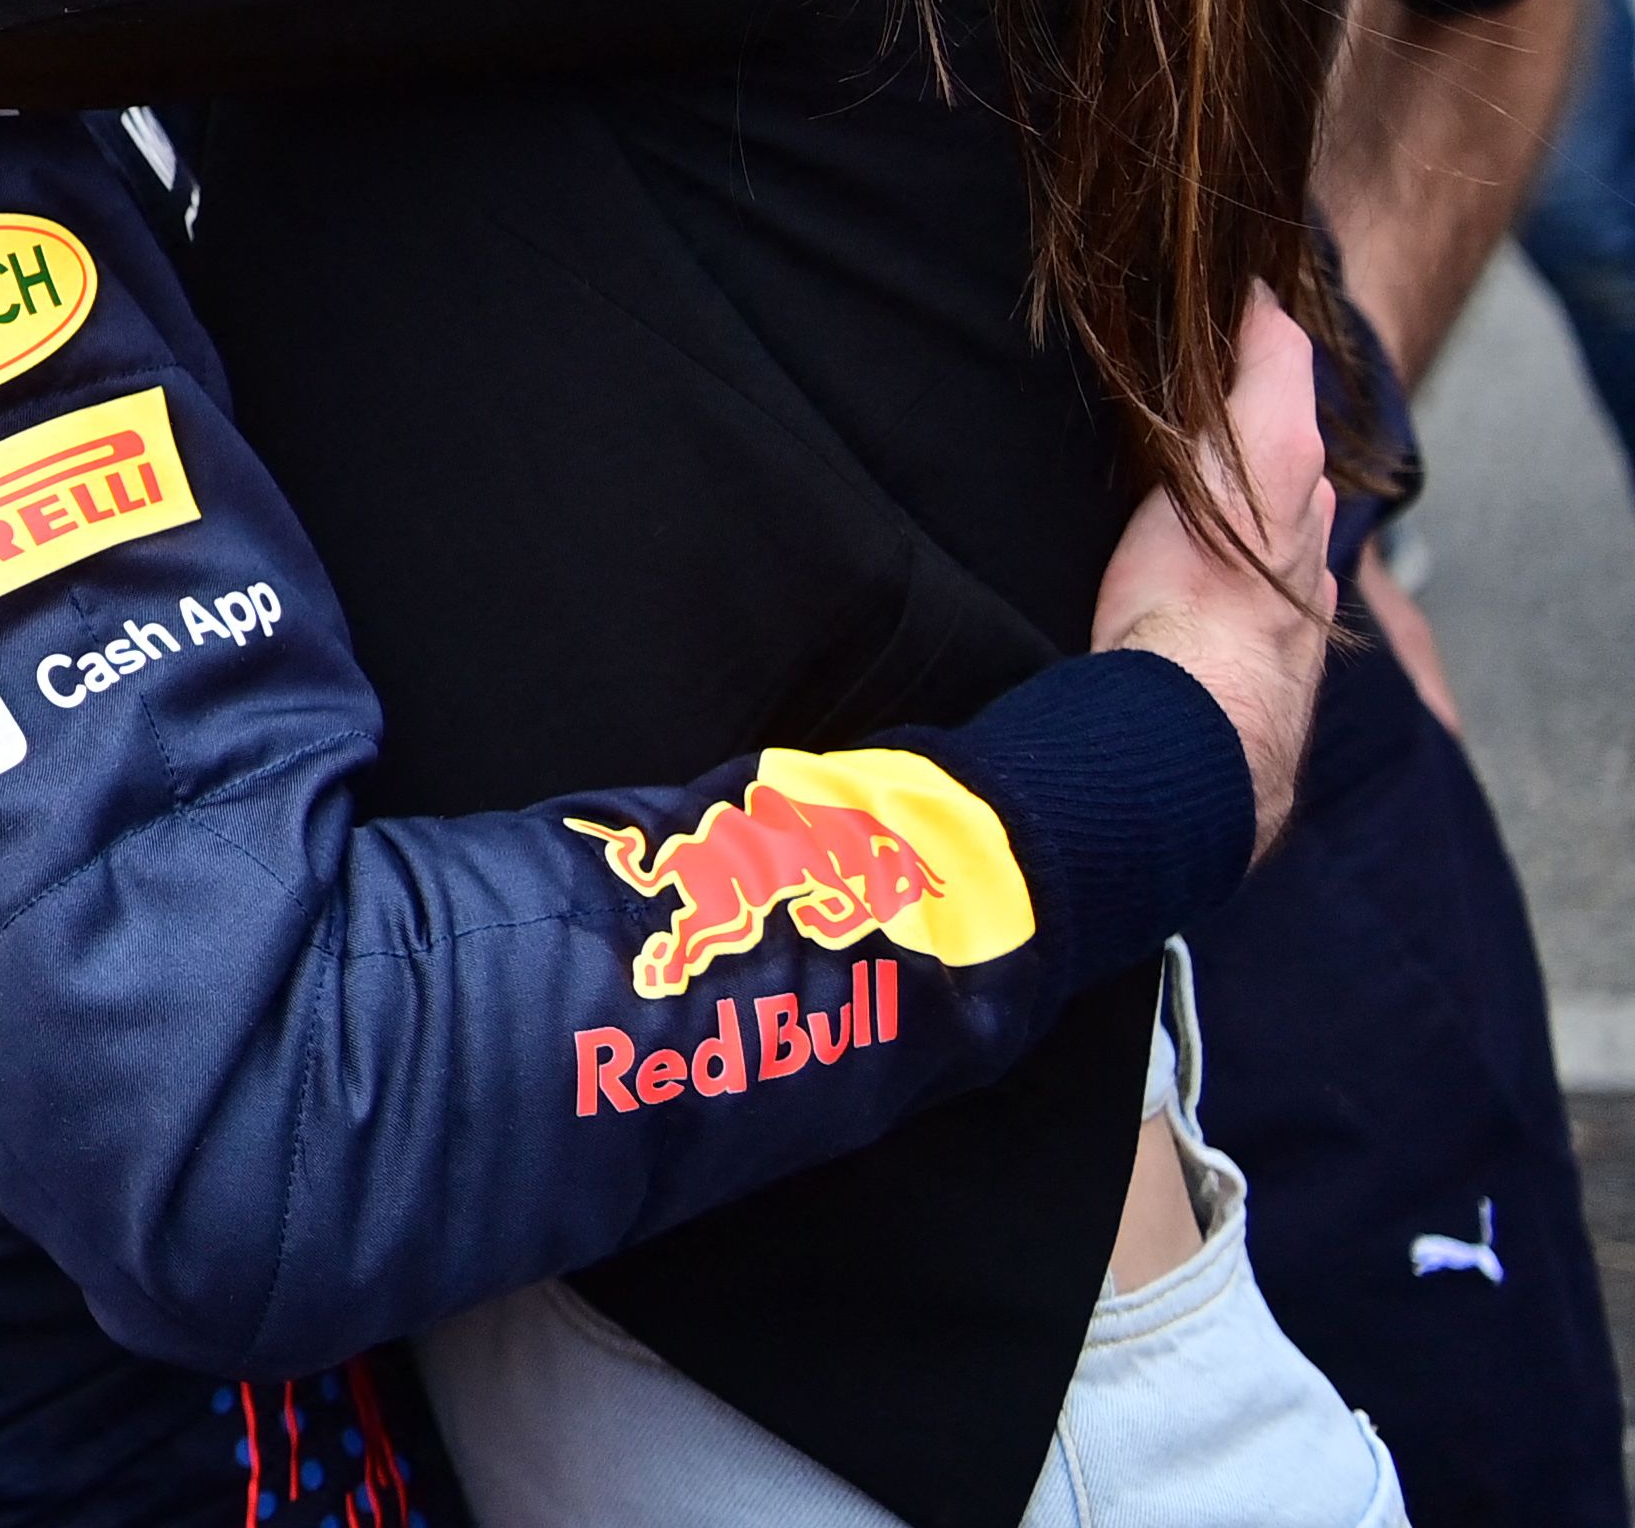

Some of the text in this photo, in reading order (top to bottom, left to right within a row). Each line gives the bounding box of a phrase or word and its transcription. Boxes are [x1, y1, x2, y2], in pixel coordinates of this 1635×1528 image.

[36, 619, 182, 709] Cash
[178, 580, 283, 648] App
[573, 958, 898, 1118] Red Bull
